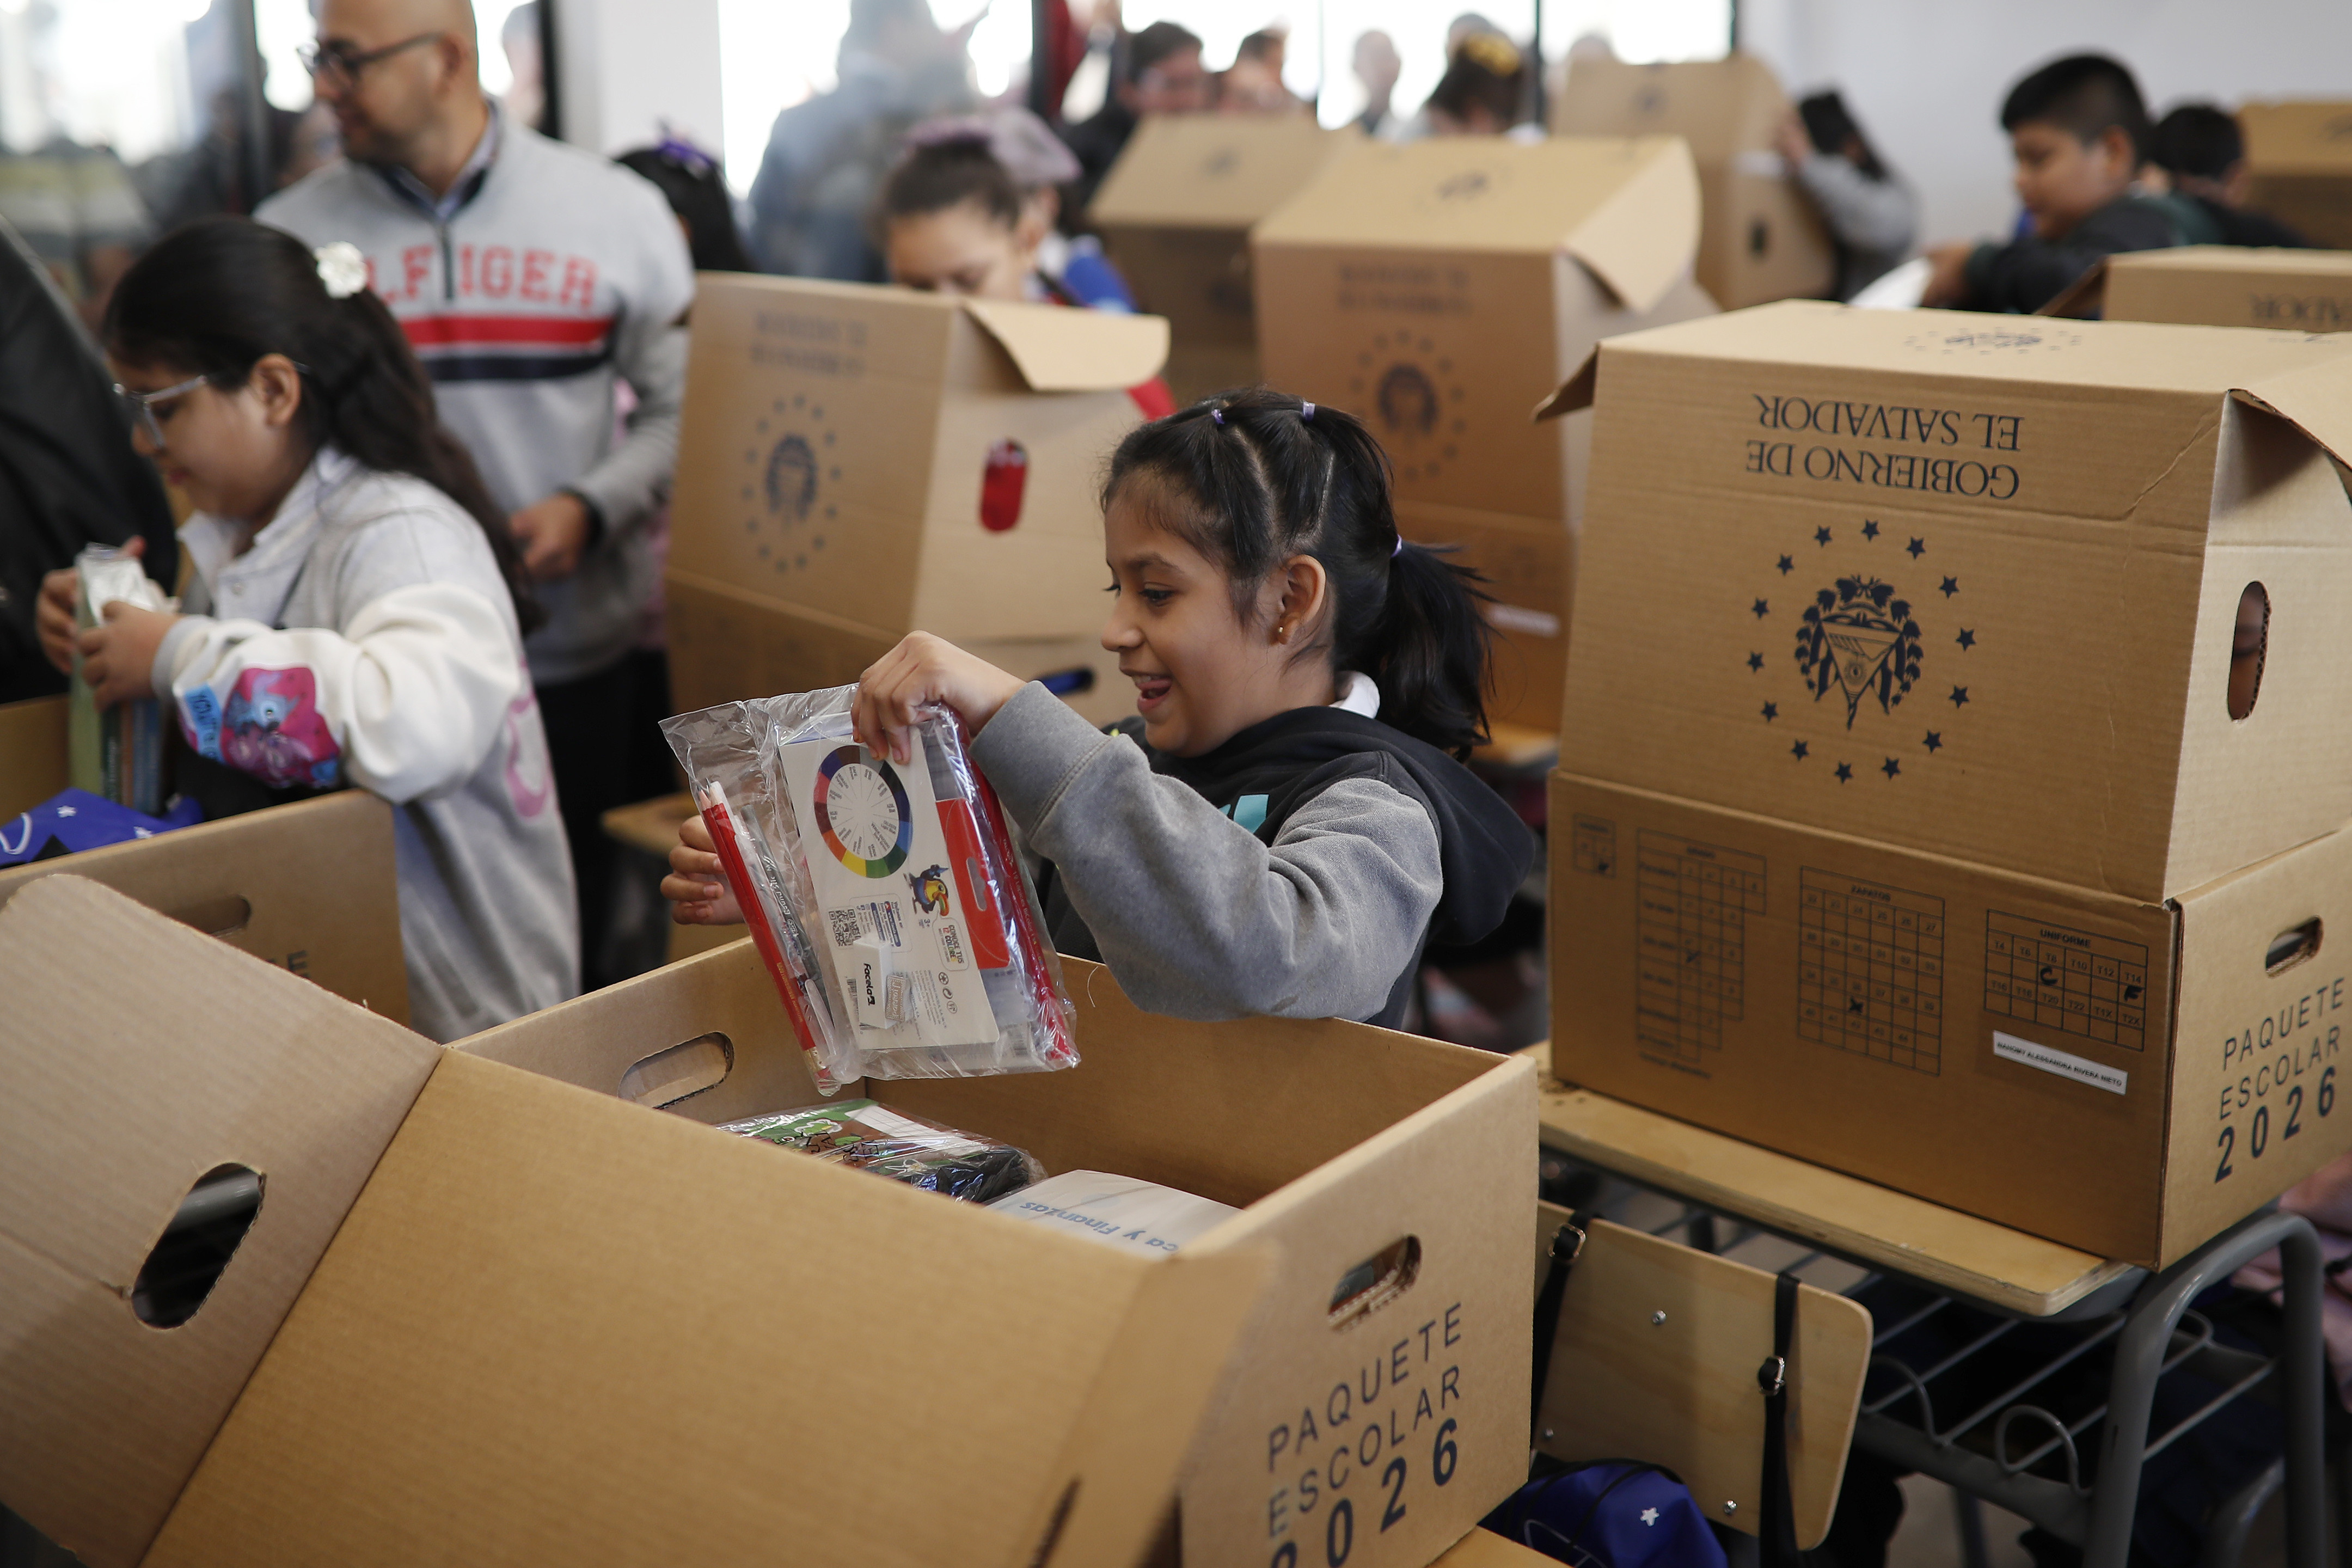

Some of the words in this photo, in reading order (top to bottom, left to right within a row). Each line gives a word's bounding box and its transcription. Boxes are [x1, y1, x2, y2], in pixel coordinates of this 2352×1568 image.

[1751, 394, 1962, 446] SALVADOR
[1972, 412, 2025, 452] EL
[1745, 439, 1796, 476] DE
[1803, 445, 2020, 500] GOBIERNO
[945, 935, 957, 962] COLORES
[948, 924, 960, 950] CONOCE
[2040, 928, 2092, 949] UNIFORME
[1994, 940, 2005, 951] T4
[2019, 946, 2031, 958] T6
[2045, 952, 2057, 964] T8
[2070, 958, 2087, 971] T10
[2097, 964, 2115, 977] T12
[2124, 971, 2142, 984] T14
[2094, 1005, 2112, 1019] T1X
[2123, 1012, 2141, 1026] T2X
[2223, 977, 2344, 1071] PAQUETE
[2073, 1066, 2099, 1079] RIVERA
[2100, 1075, 2122, 1087] NIETO
[2220, 1025, 2340, 1120] ESCOLAR
[2214, 1064, 2336, 1184] 2026
[1019, 1201, 1120, 1235] Finanzas
[1269, 1302, 1462, 1472] PAQUETE
[1269, 1365, 1460, 1538] ESCOLAR
